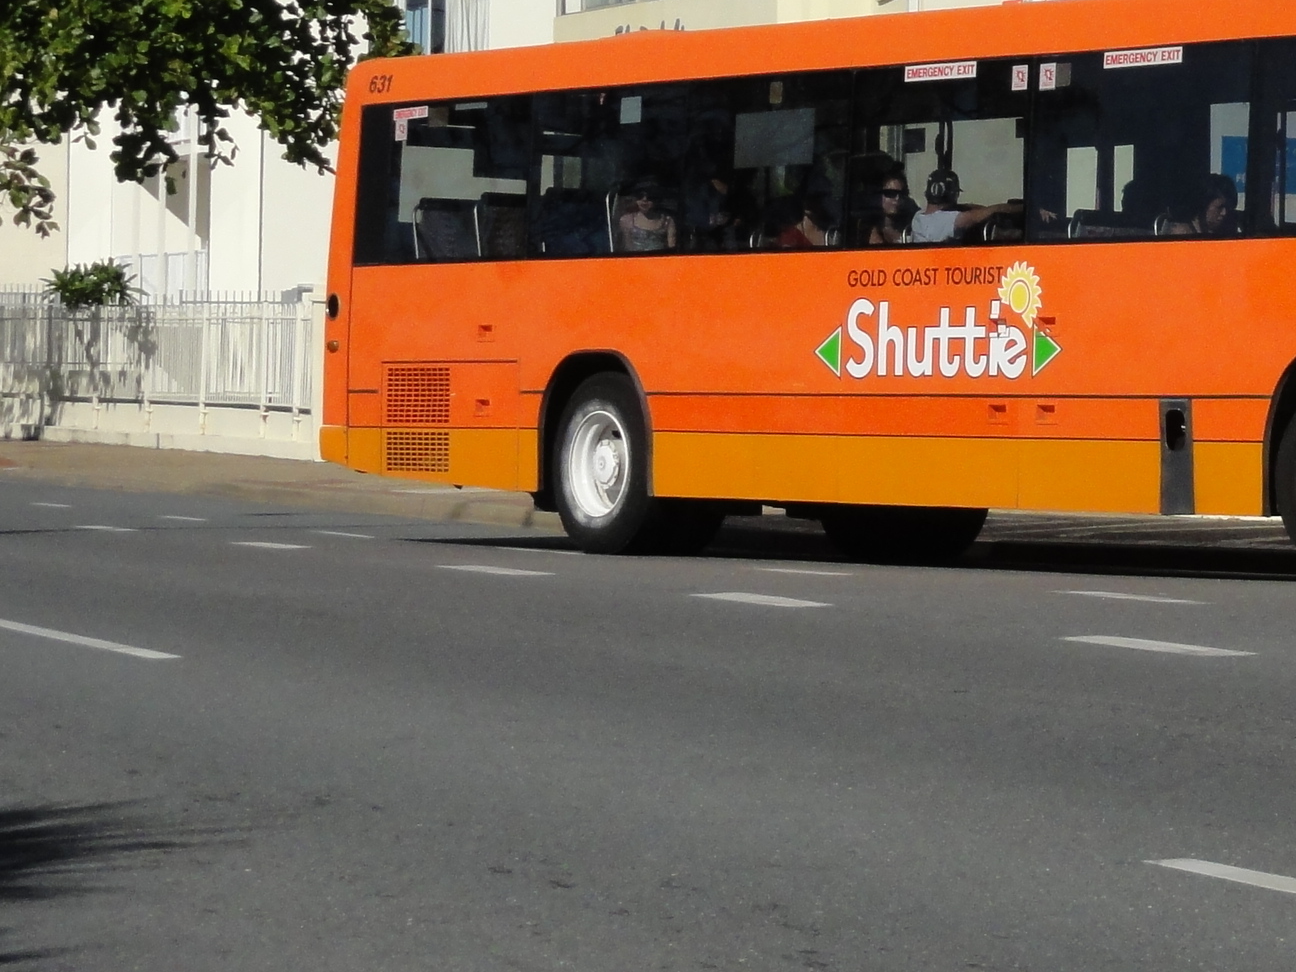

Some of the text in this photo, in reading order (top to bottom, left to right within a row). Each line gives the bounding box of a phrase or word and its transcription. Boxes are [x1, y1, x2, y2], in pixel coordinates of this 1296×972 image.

[1105, 49, 1181, 65] EMERGENCY EXIT
[906, 64, 975, 78] EMERGENCY EXIT
[369, 75, 393, 93] 631
[847, 266, 1003, 288] GOLD COAST TOURIST
[845, 297, 1028, 379] Shuttle
